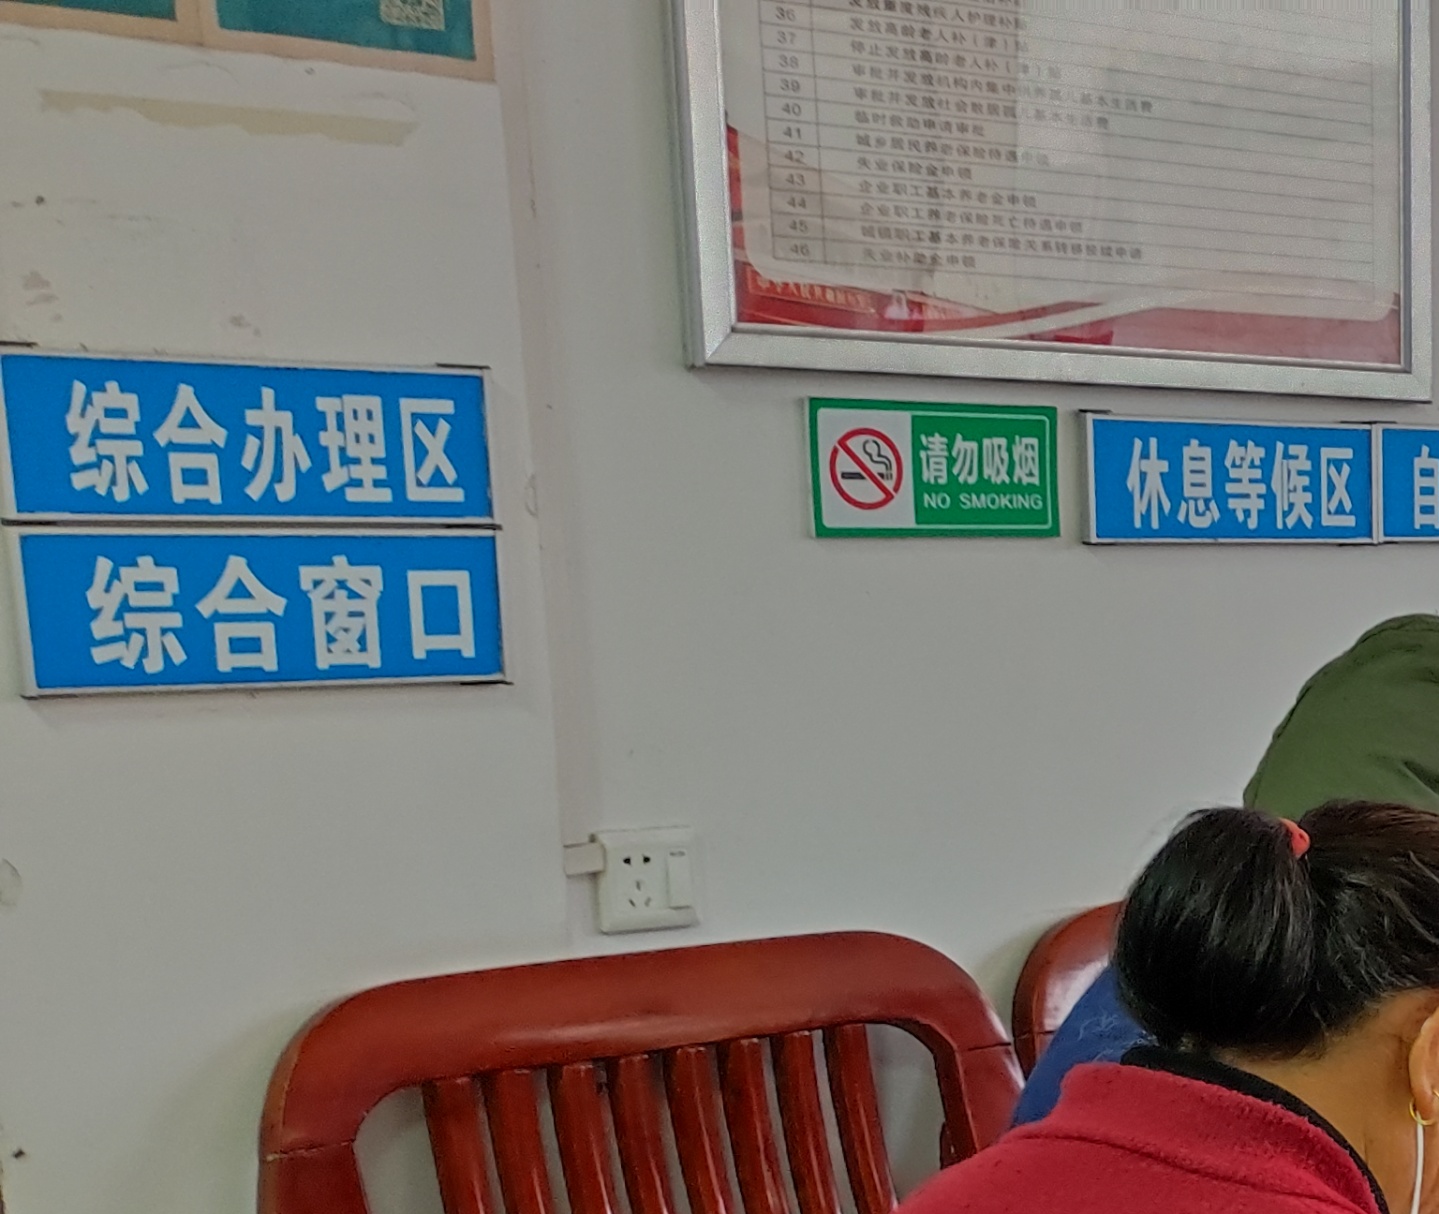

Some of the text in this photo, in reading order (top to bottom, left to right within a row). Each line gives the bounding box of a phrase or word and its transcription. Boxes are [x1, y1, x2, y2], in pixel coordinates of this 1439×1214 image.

[776, 7, 796, 22] 36
[776, 30, 797, 45] 37
[778, 54, 799, 69] 38
[779, 78, 800, 93] 39
[781, 102, 801, 116] 40
[782, 125, 802, 140] 41
[783, 149, 805, 165] 42
[785, 173, 805, 188] 43
[788, 196, 806, 210] 44
[789, 218, 808, 234] 45
[790, 242, 810, 257] 46
[65, 379, 465, 504] 综合办理区
[920, 433, 1041, 486] 请勿吸烟
[1127, 437, 1356, 531] 休息等候区
[922, 493, 1043, 512] NO SMOKING
[86, 553, 477, 674] 综合窗口
